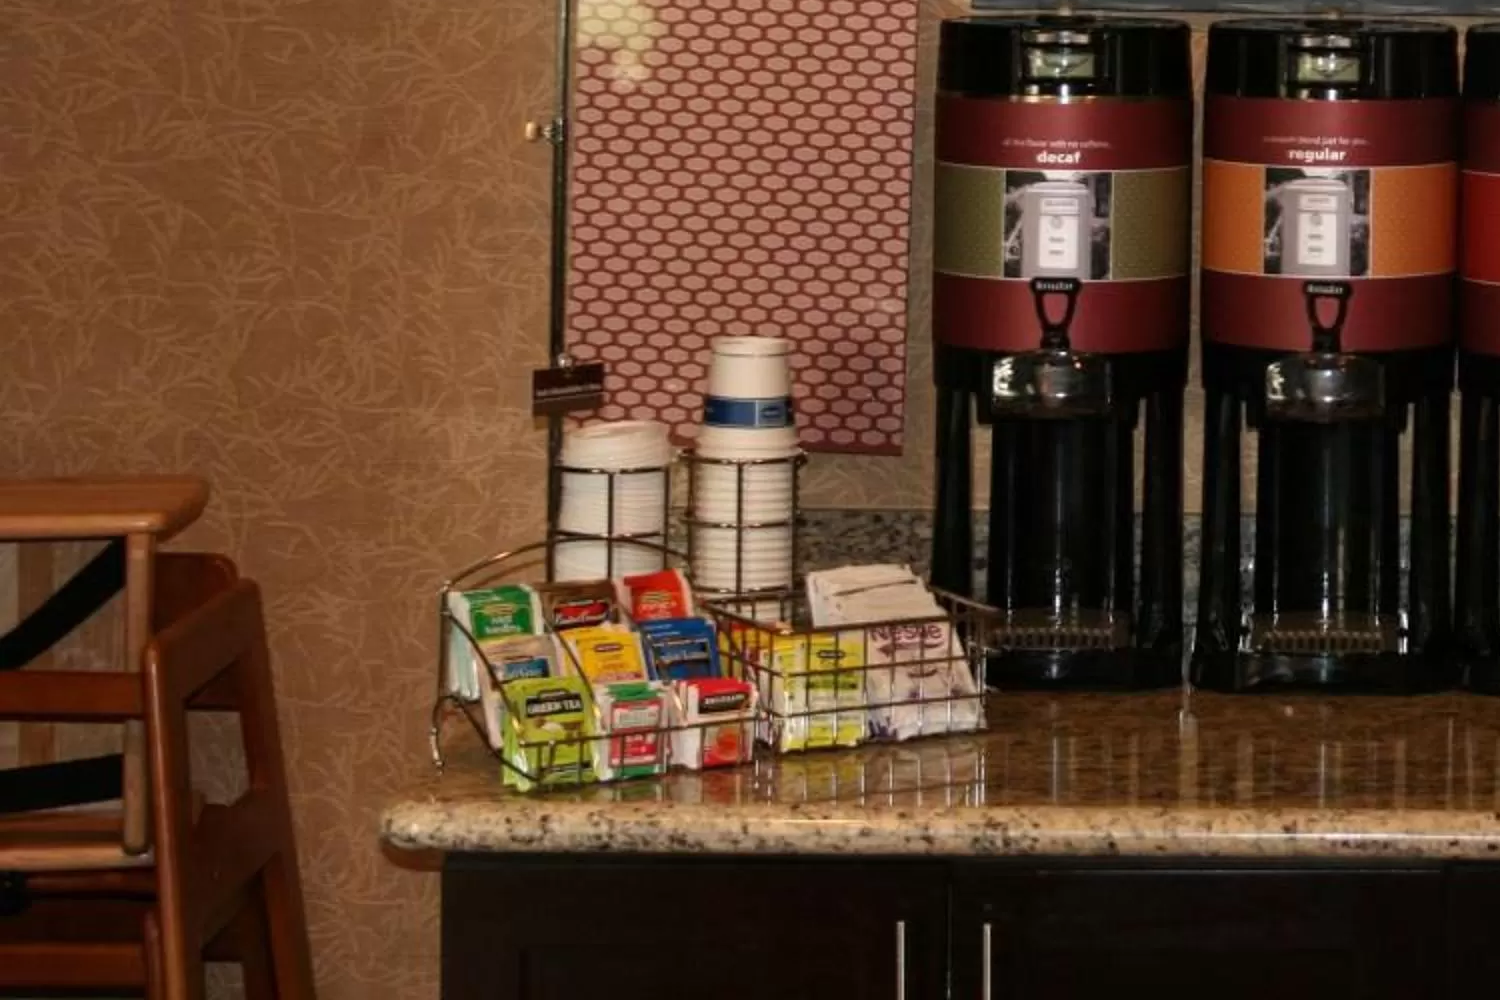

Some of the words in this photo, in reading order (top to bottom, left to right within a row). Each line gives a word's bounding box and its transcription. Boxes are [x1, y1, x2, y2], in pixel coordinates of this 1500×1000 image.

[1035, 149, 1082, 164] decaf
[1287, 147, 1348, 164] regular
[526, 701, 561, 715] GREEN
[562, 699, 582, 711] TEA
